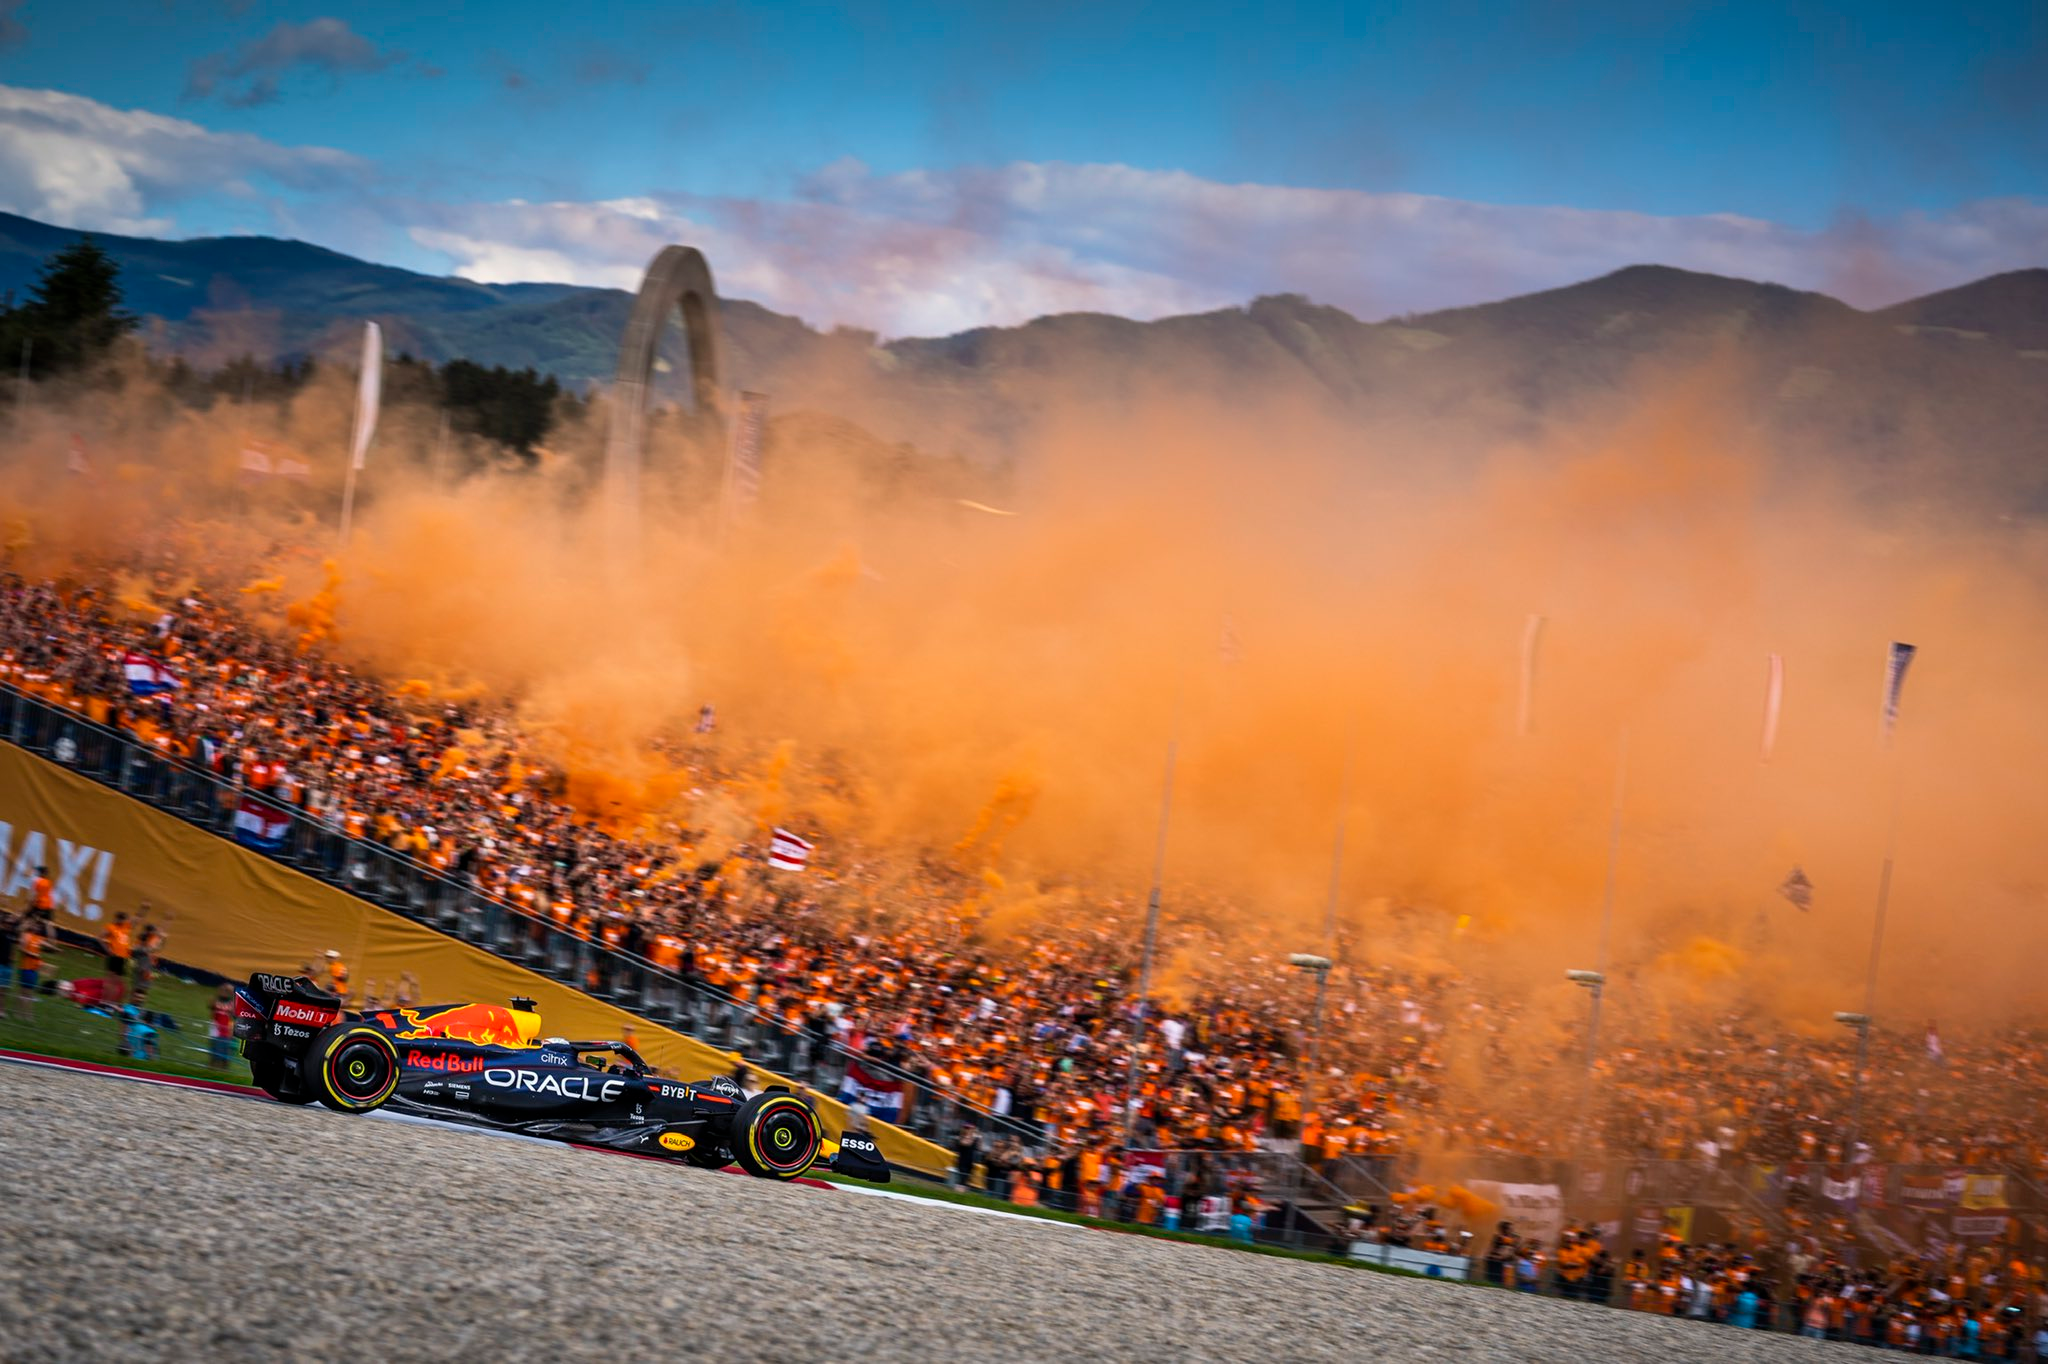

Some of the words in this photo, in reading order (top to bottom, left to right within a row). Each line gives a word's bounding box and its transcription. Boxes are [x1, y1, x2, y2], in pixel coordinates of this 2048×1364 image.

[240, 1010, 256, 1019] COLA
[276, 1004, 315, 1021] Mobil
[376, 1012, 398, 1029] 1
[283, 1025, 310, 1039] Tezos
[407, 1050, 446, 1070] Red
[447, 1054, 484, 1073] Bull
[541, 1053, 568, 1067] citrix
[448, 1082, 471, 1091] SIEMENS
[484, 1068, 625, 1103] ORACLE
[661, 1085, 697, 1101] BYBIT
[668, 1137, 691, 1148] RAUCH
[841, 1137, 875, 1152] ESSO
